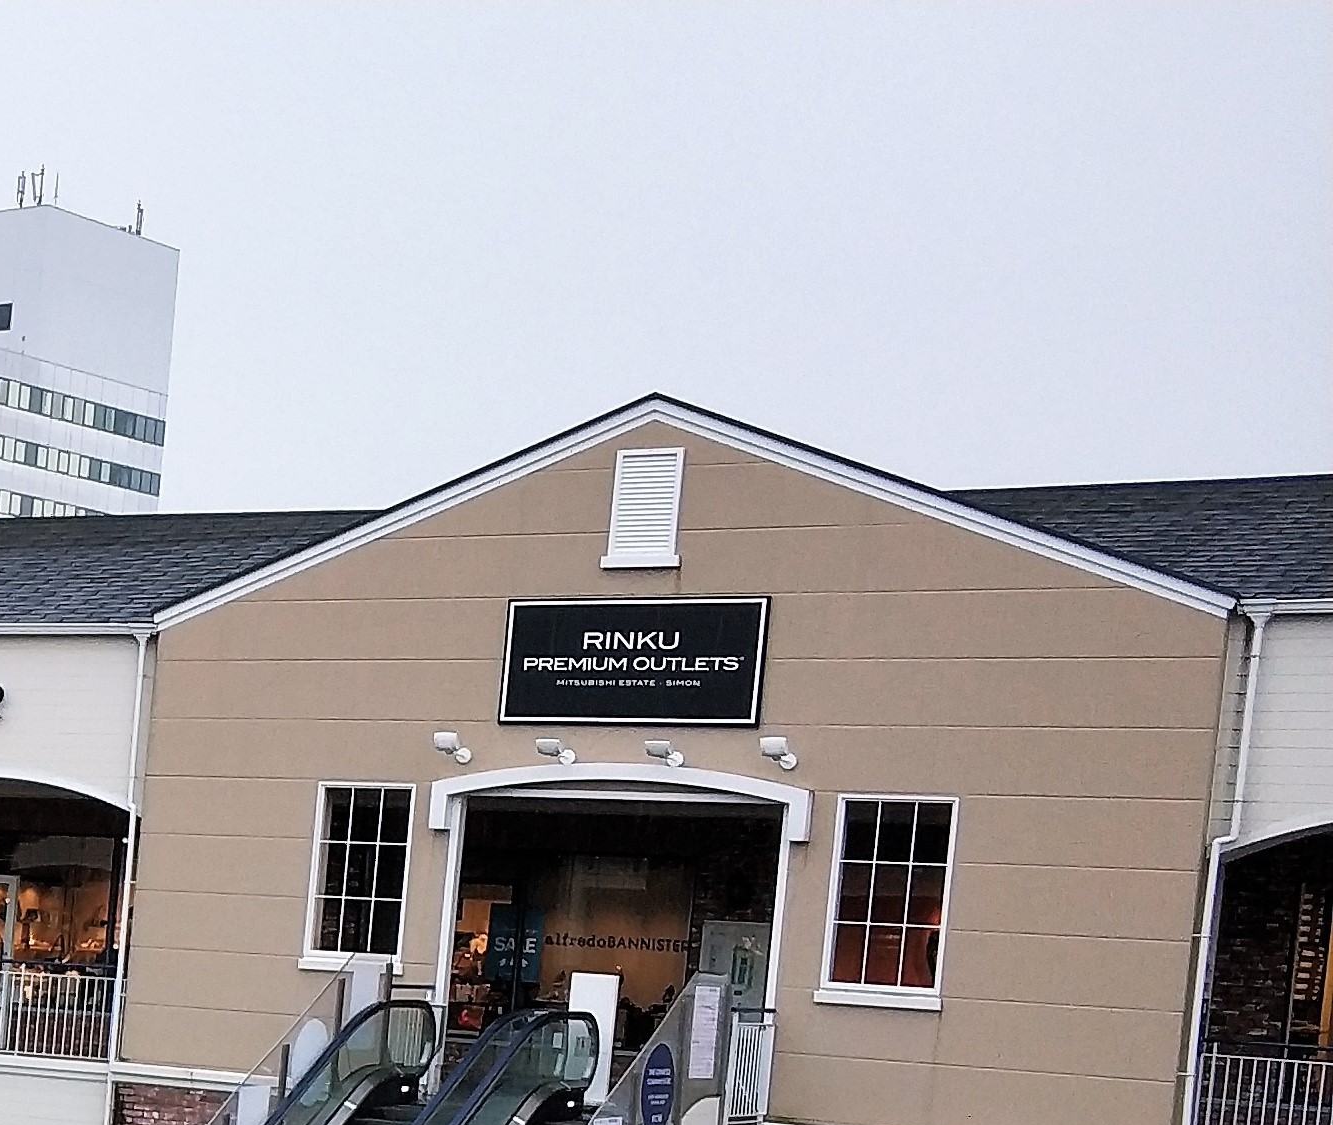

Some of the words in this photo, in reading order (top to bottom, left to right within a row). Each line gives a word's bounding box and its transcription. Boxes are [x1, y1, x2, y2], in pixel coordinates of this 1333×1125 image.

[582, 631, 680, 650] RINKU
[523, 656, 628, 672] PREMIUM
[555, 679, 617, 688] MITSUBISHI
[618, 679, 656, 688] ESTATE
[665, 679, 702, 688] SIMON
